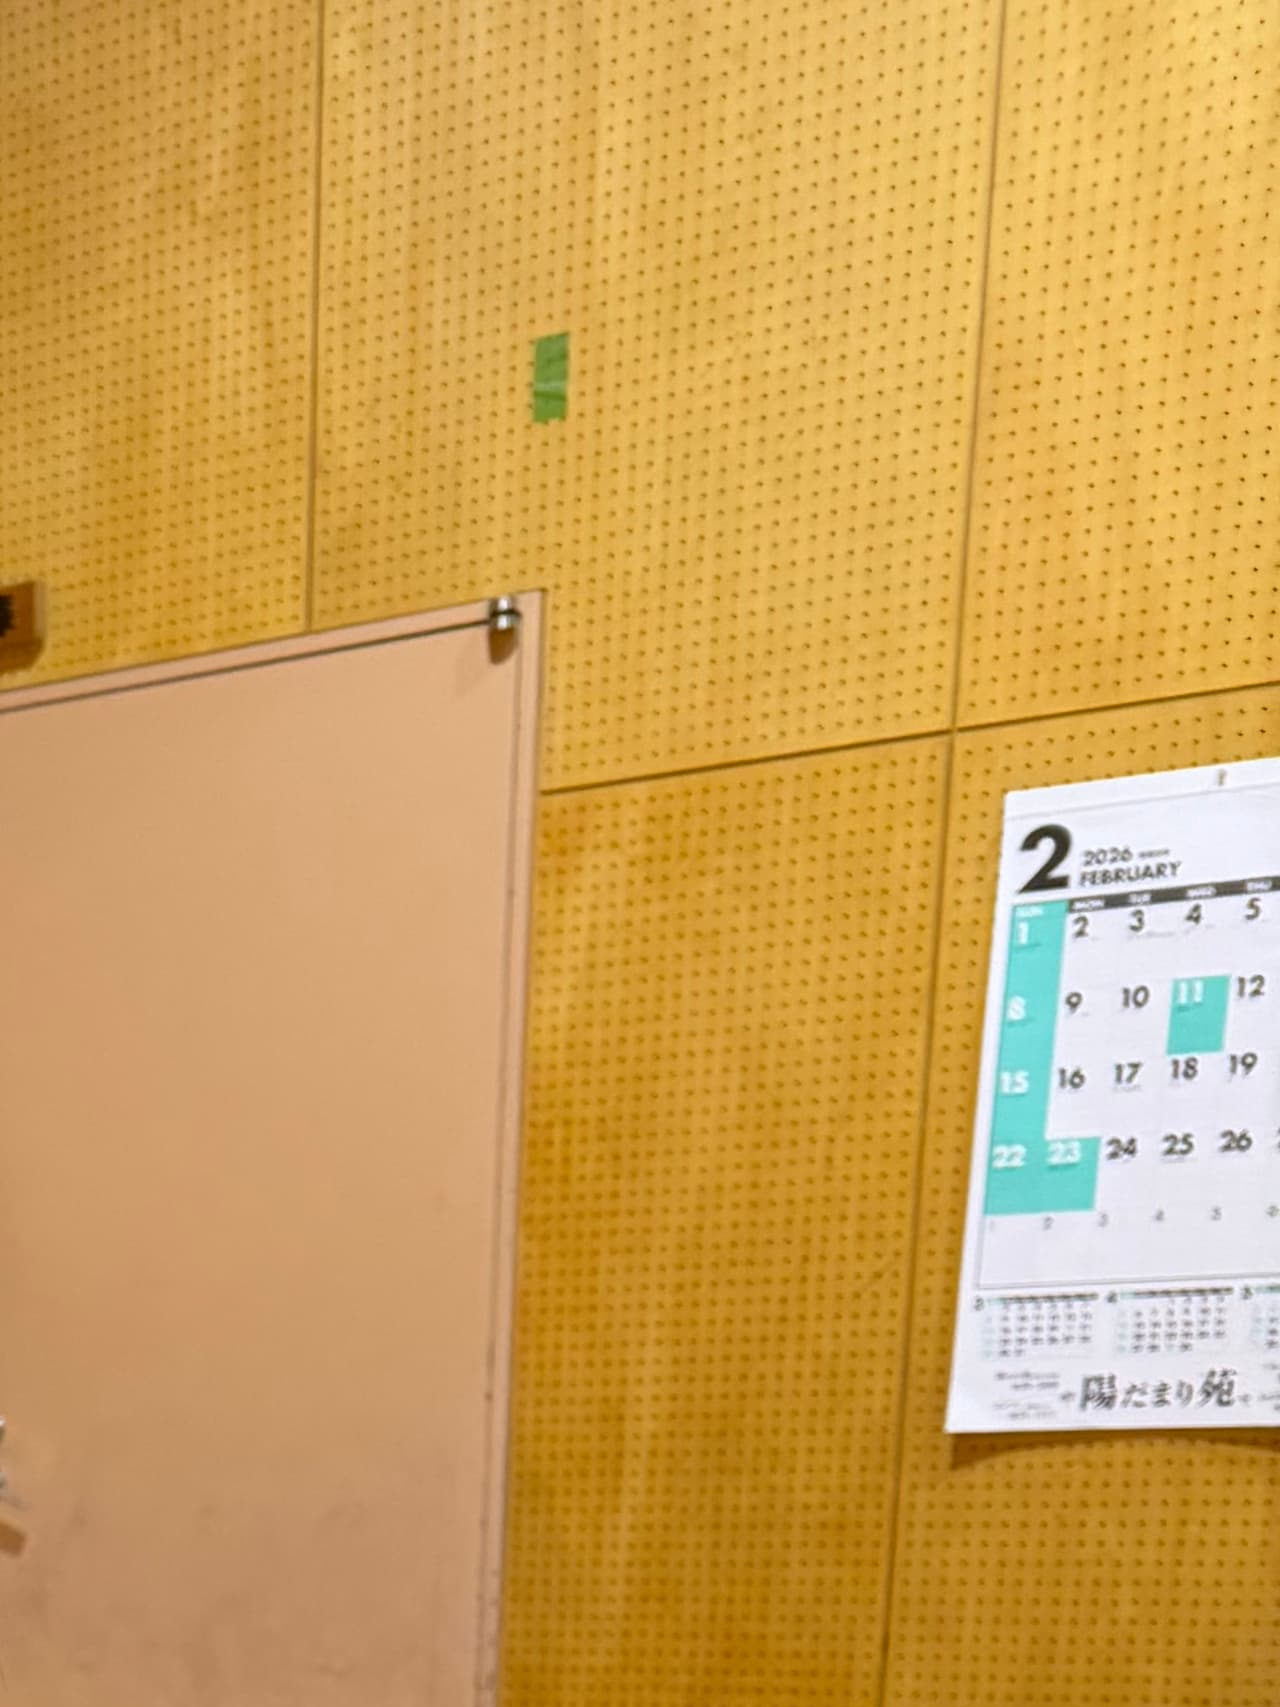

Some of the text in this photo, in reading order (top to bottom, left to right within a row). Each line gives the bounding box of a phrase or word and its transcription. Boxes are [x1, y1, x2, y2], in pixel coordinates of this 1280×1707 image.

[1017, 824, 1072, 894] 2
[1079, 861, 1182, 886] FEBRUARY
[1083, 846, 1133, 867] 2026
[1017, 921, 1029, 945] 1
[1073, 916, 1089, 939] 2
[1129, 909, 1145, 932] 3
[1185, 903, 1202, 925] 4
[1244, 897, 1262, 921] 5
[1007, 974, 1266, 1021] 8 9 10 11 12
[1000, 1052, 1258, 1094] 15 16 17 18 19
[992, 1129, 1253, 1168] 22 23 24 25 26
[1080, 1368, 1237, 1411] 陽だまり苑
